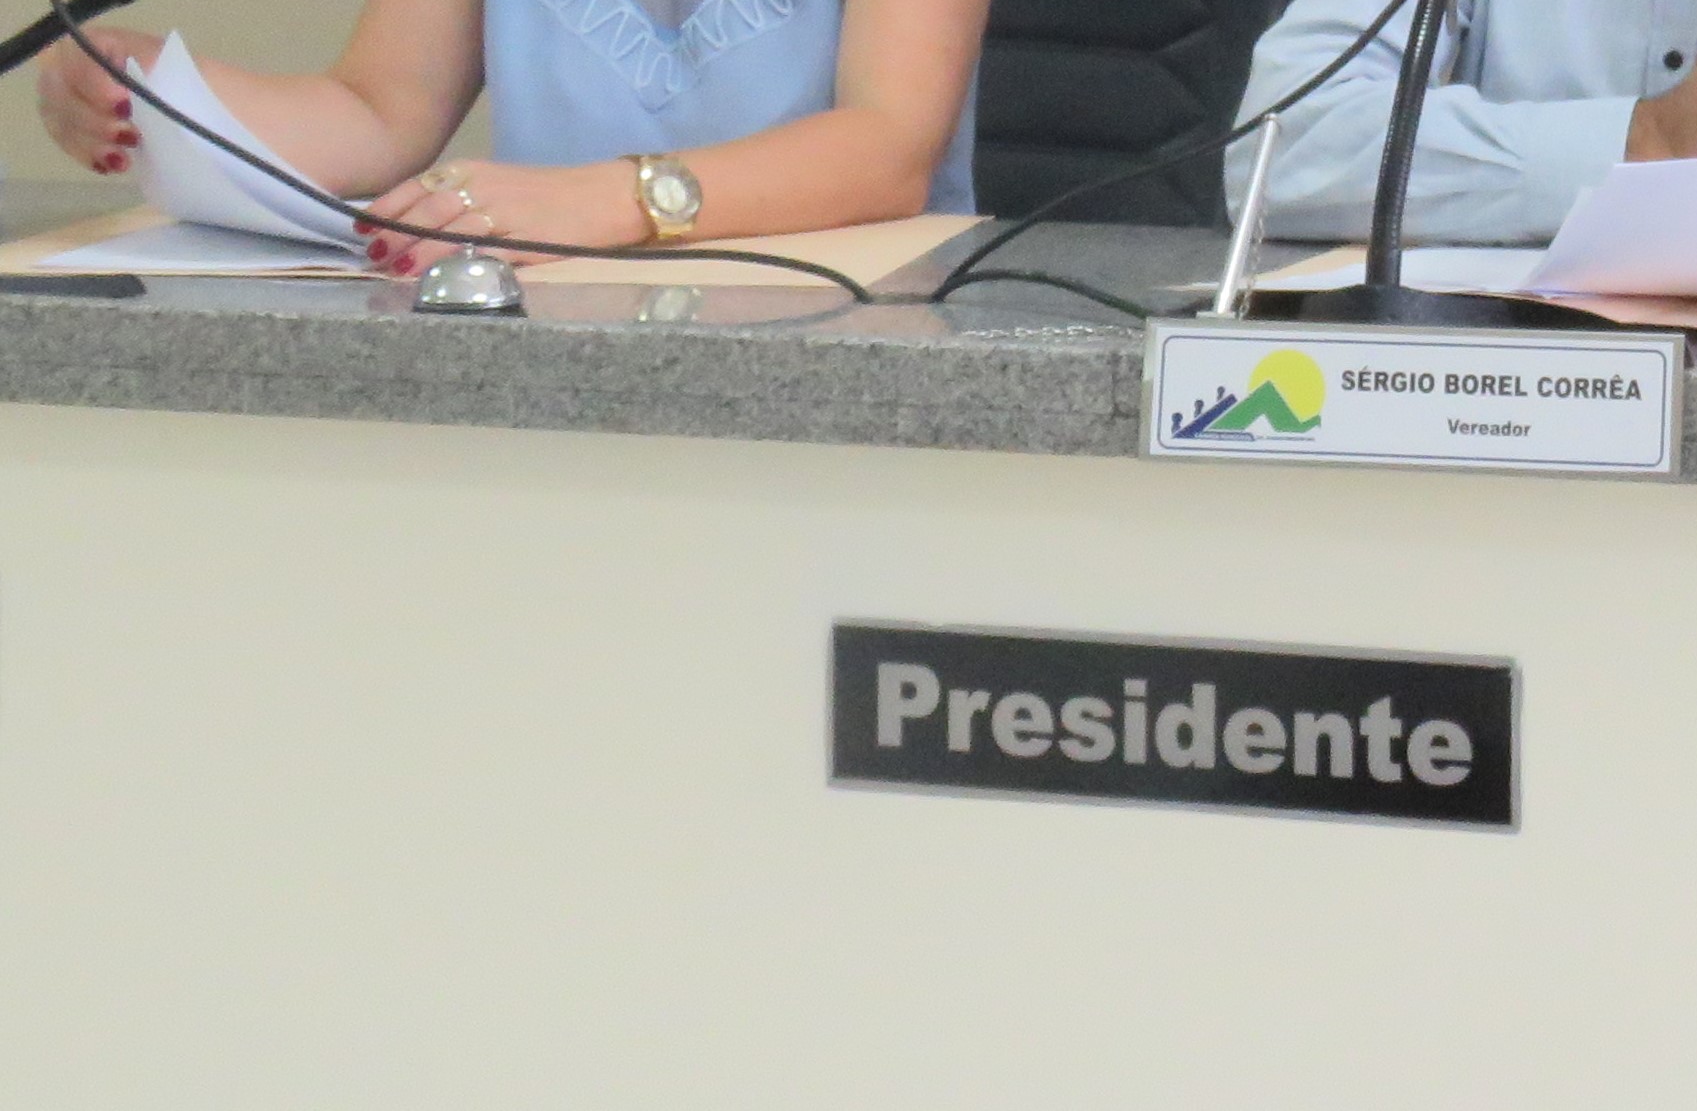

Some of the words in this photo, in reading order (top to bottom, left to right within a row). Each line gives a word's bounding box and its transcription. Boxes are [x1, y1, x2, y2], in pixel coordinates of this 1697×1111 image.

[1341, 365, 1435, 394] SÉRGIO
[1444, 373, 1528, 397] BOREL
[1537, 374, 1642, 401] CORRÊA
[1447, 418, 1531, 437] Vereador
[876, 661, 1473, 786] Presidente
